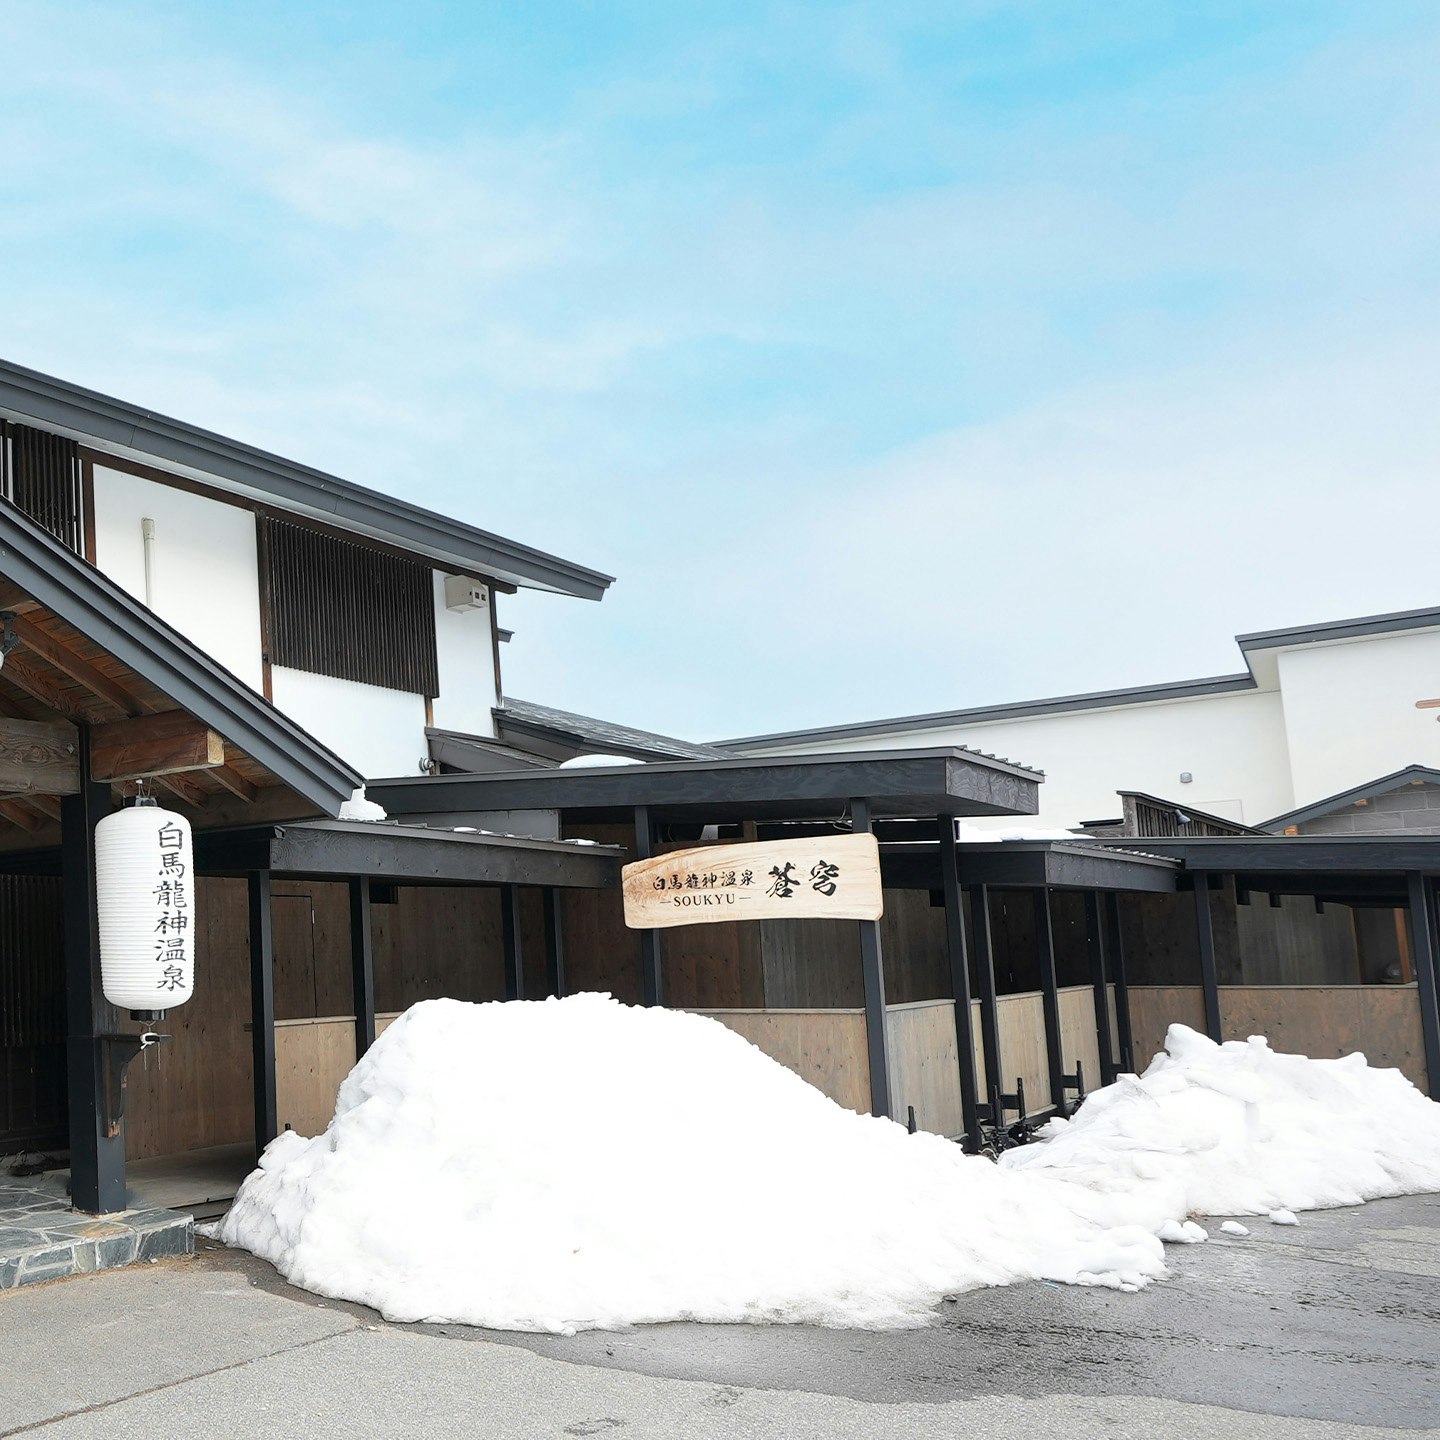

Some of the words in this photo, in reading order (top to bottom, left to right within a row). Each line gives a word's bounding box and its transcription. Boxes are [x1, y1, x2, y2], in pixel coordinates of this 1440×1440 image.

[152, 820, 188, 993] 白馬龍神温泉
[652, 869, 757, 891] 白馬龍神温泉
